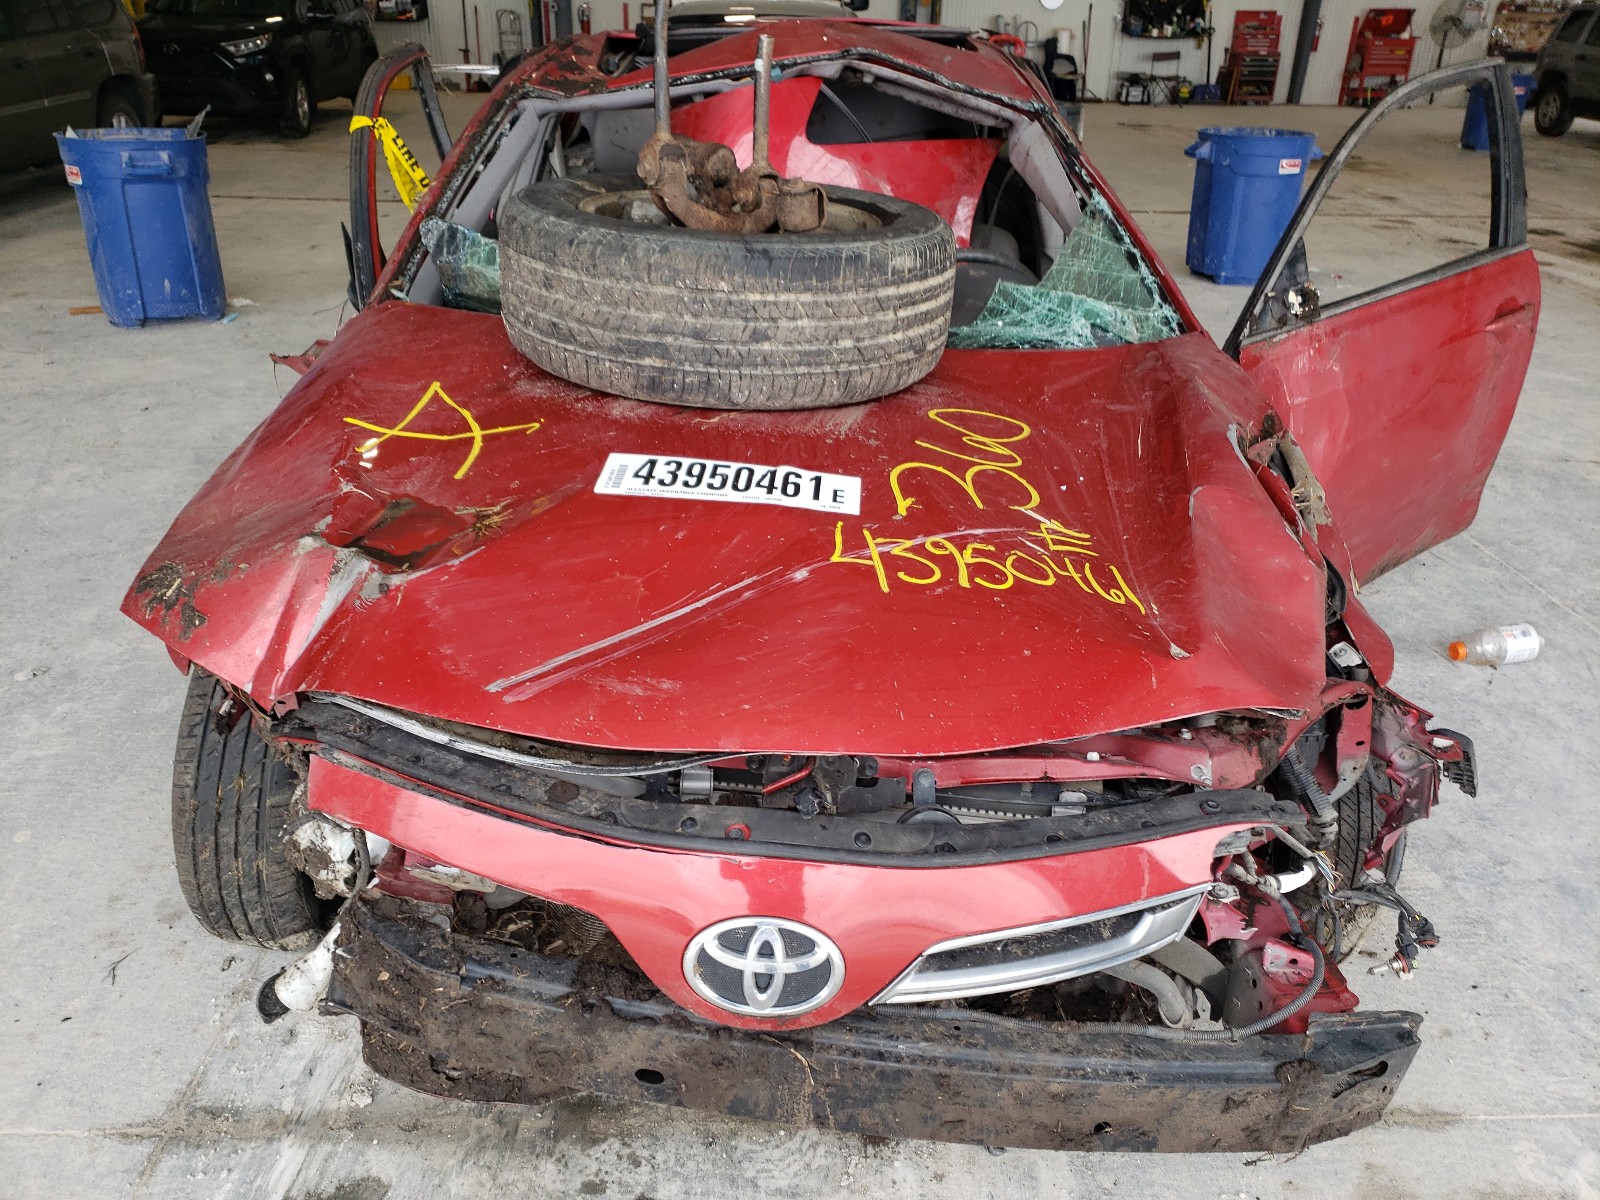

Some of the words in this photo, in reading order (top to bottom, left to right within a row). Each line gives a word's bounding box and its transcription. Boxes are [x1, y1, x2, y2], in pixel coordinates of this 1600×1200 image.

[632, 458, 822, 501] 43950461
[831, 488, 845, 504] E
[830, 521, 1146, 615] 43950461
